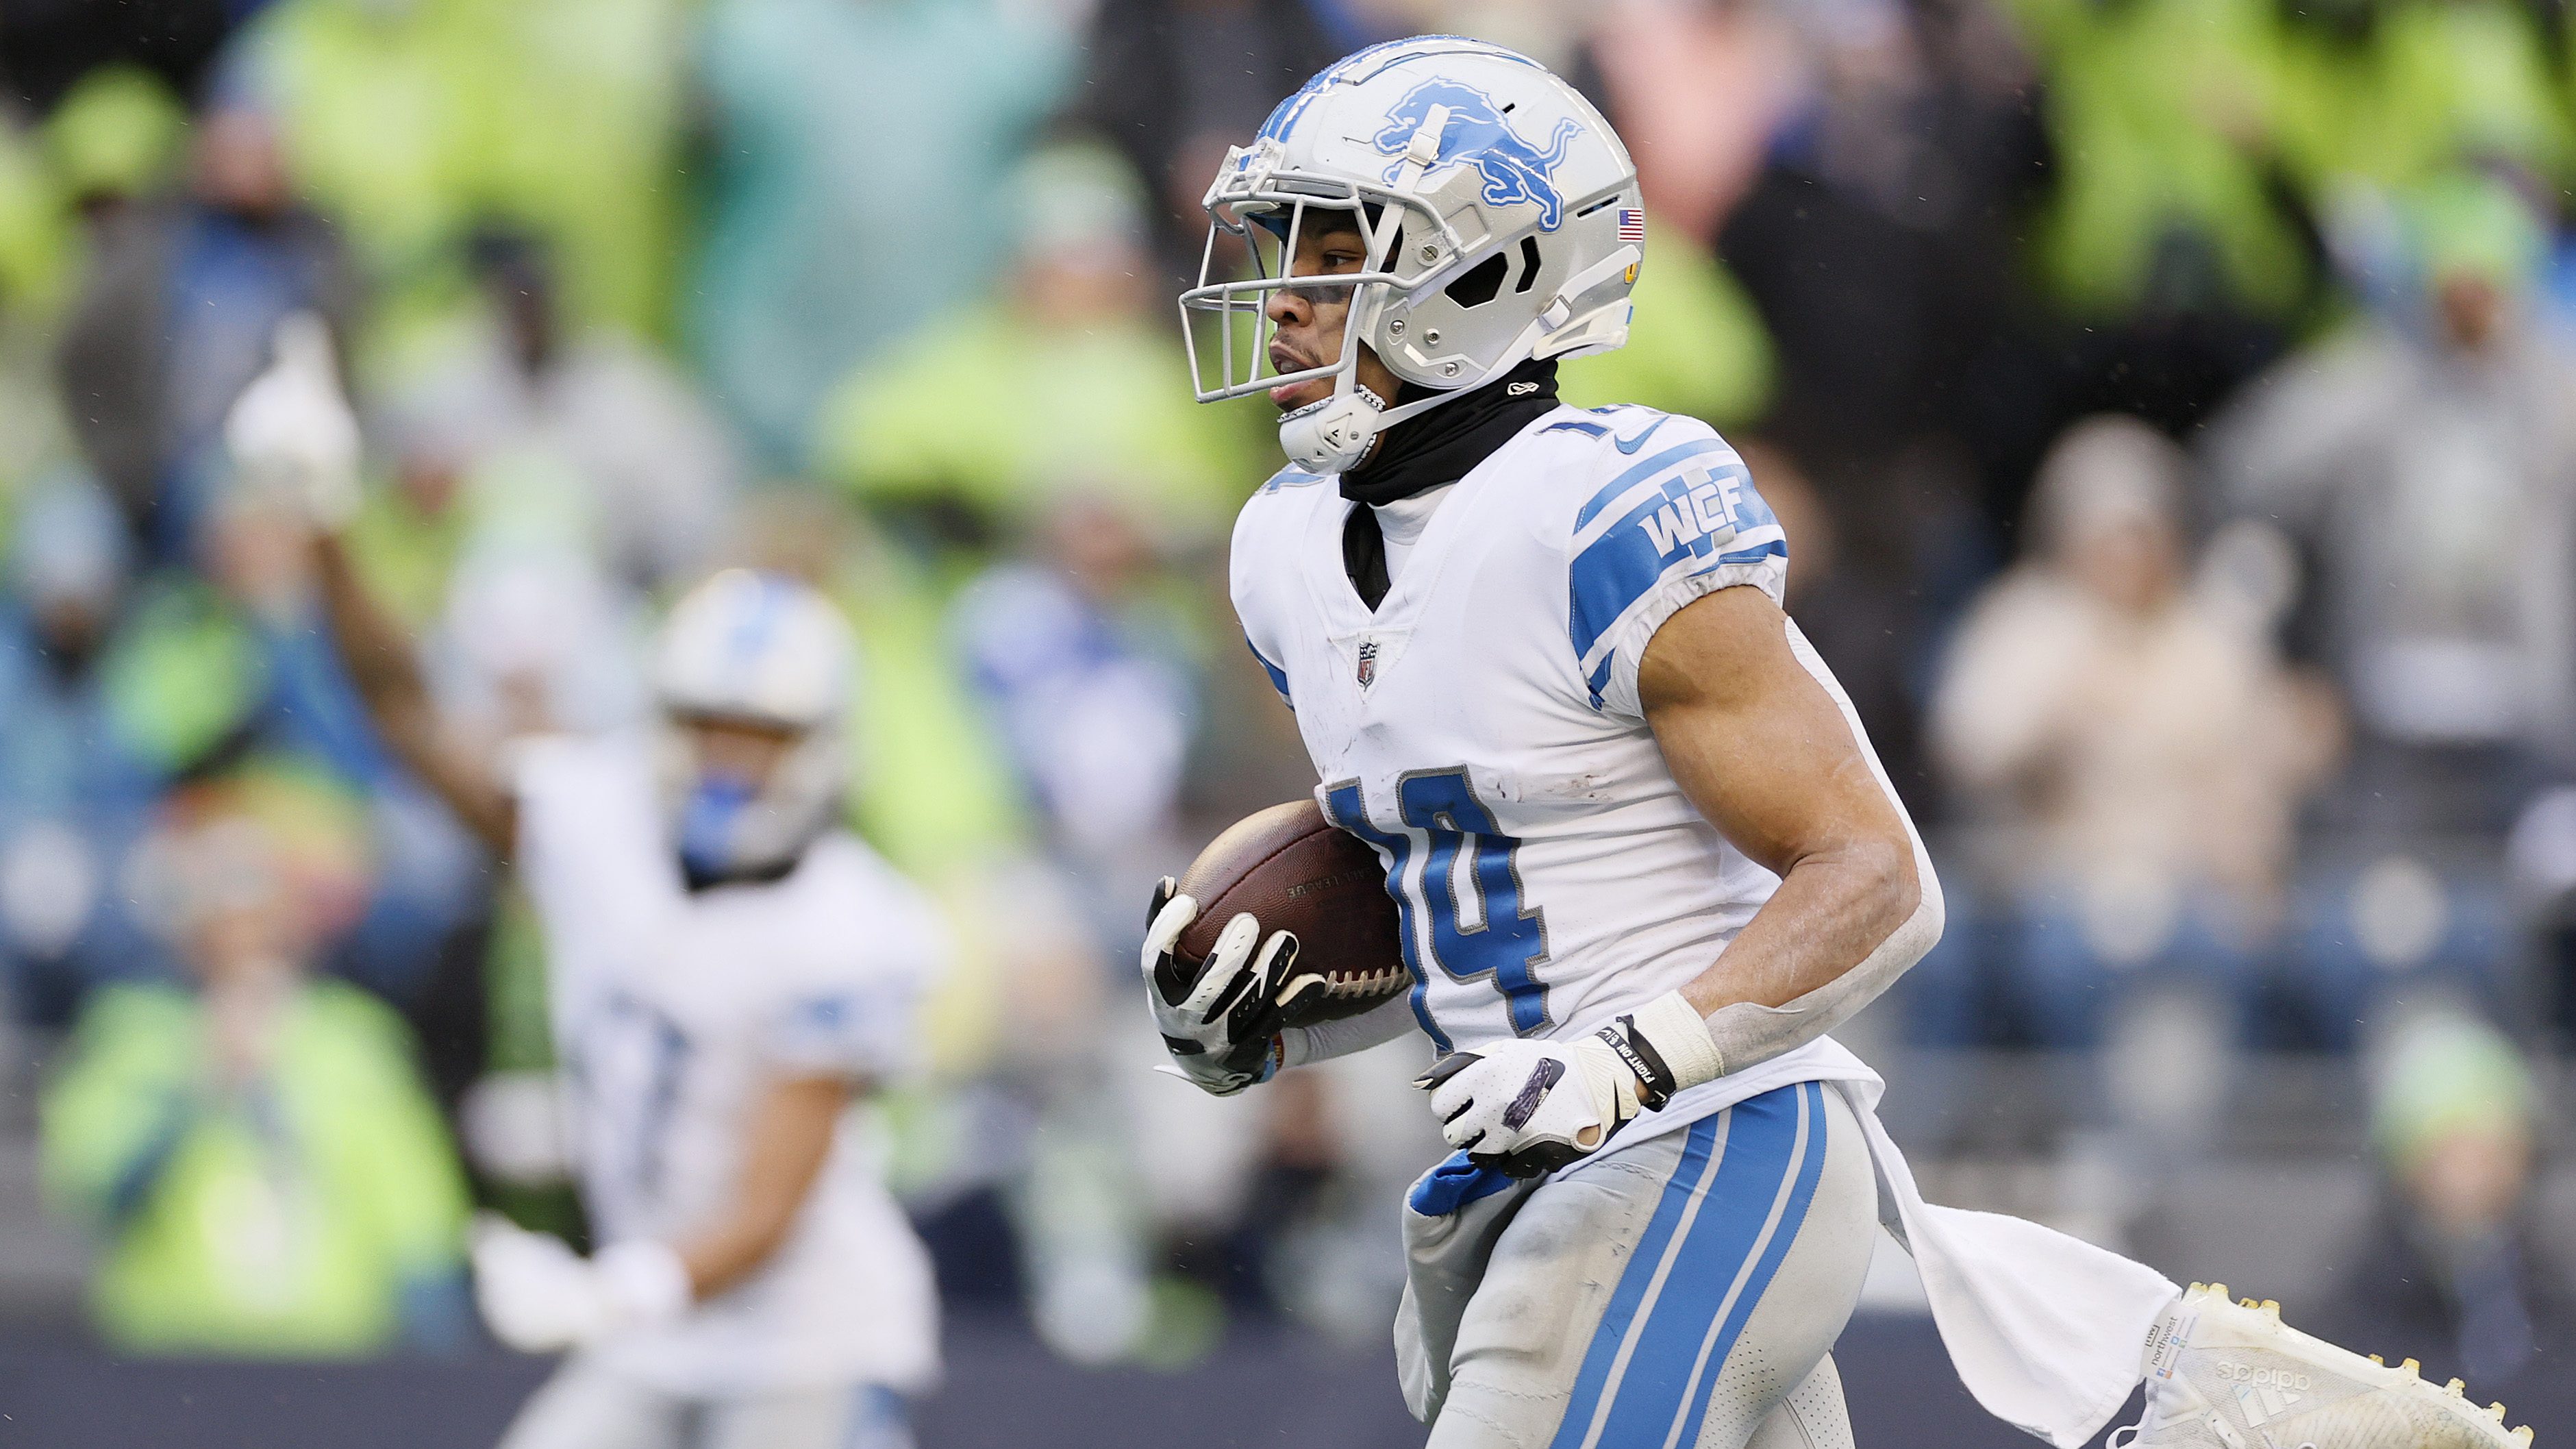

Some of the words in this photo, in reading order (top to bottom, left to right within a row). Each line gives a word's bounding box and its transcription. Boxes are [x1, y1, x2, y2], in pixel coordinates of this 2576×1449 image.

[1636, 475, 1745, 559] WCF
[1359, 659, 1373, 681] NFL
[1325, 764, 1558, 1061] 14
[1616, 1043, 1633, 1058] ON
[1627, 1056, 1655, 1084] FIGHT
[2151, 1315, 2178, 1366] northwest
[2216, 1361, 2312, 1392] adidas
